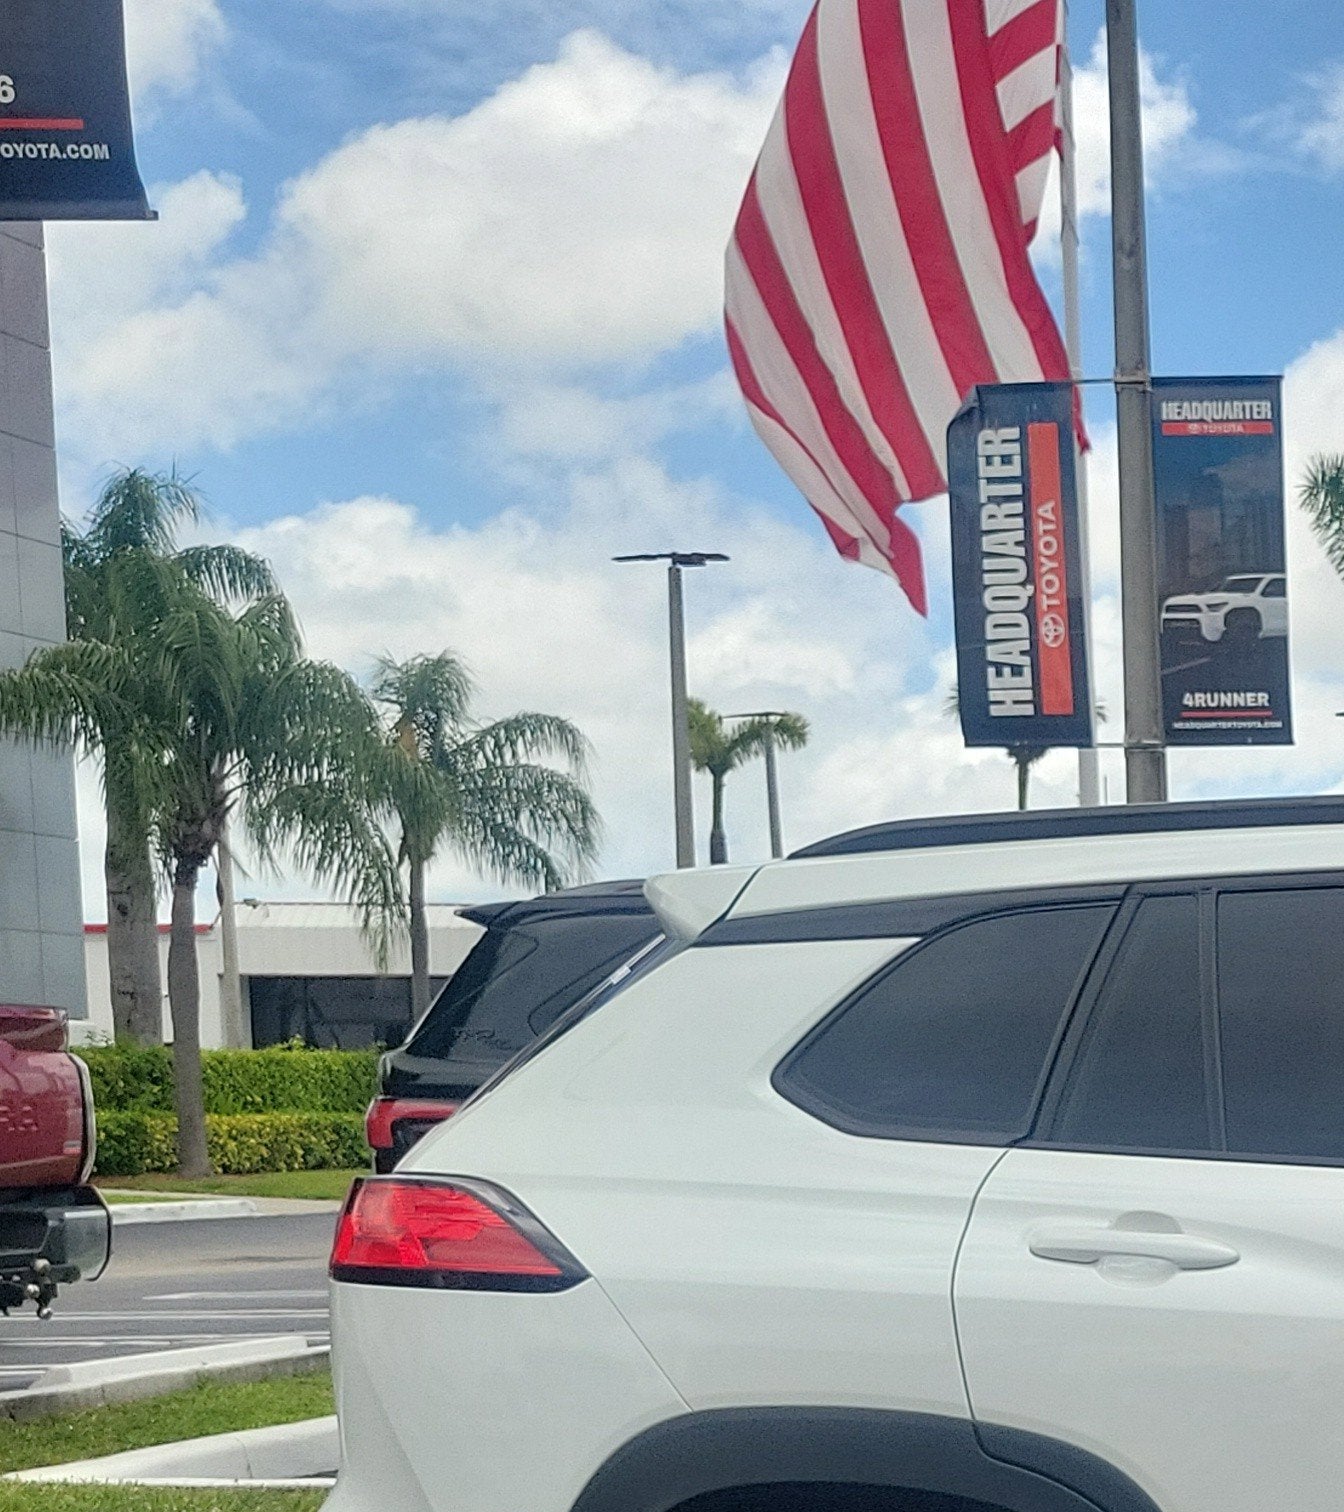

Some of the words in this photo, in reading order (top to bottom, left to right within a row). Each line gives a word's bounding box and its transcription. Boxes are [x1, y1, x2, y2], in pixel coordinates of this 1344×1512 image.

[1162, 400, 1272, 423] HEADQUARTER
[977, 426, 1035, 717] HEADQUARTER
[1037, 500, 1062, 612] TOYOTA
[1183, 692, 1270, 707] 4RUNNER
